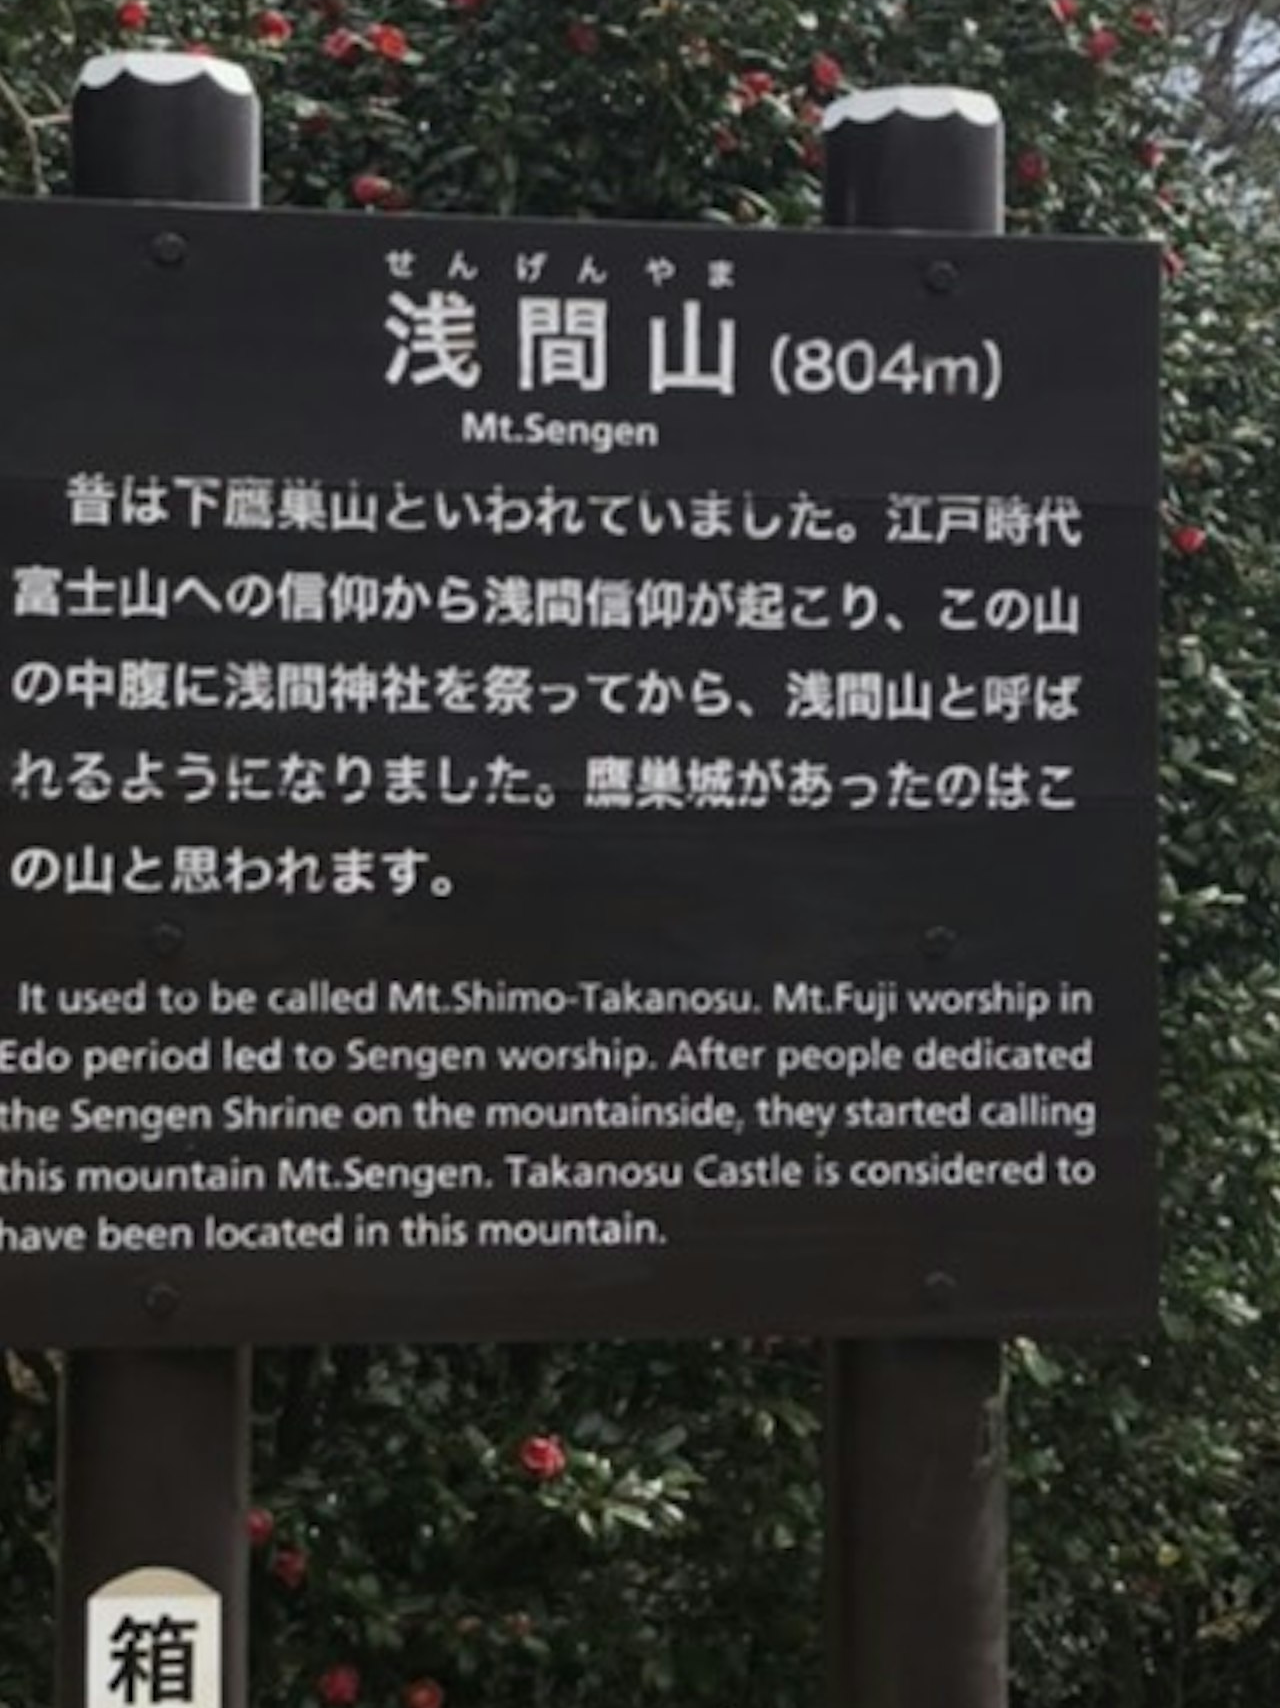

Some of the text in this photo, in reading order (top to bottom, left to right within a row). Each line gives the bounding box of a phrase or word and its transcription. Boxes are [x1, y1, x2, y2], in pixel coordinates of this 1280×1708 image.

[385, 250, 734, 288] せんげんやま
[384, 291, 1003, 400] 浅間山 (804m)
[461, 410, 659, 453] Mt.Sengen
[12, 564, 1080, 635] 富士山への信仰から浅間信仰が起こり、この山
[11, 657, 1082, 724] の中腹に浅間神社を祭ってから、浅間山と呼ば
[10, 844, 456, 897] の山と思われます。
[20, 980, 1092, 1022] It used to be called Mt.Shimo-Takanosu. Mt.Fuji worship in
[84, 1038, 210, 1080] period
[223, 1037, 282, 1072] led
[294, 1043, 335, 1071] to
[346, 1038, 485, 1079] Sengen
[498, 1037, 656, 1078] worship.
[669, 1036, 765, 1070] After
[777, 1038, 903, 1077] people
[913, 1037, 1092, 1070] dedicated
[71, 1098, 212, 1141] Sengen
[223, 1096, 343, 1130] Shrine
[352, 1103, 402, 1129] on
[413, 1095, 475, 1129] the
[486, 1094, 744, 1133] mountainside,
[755, 1094, 836, 1137] they
[845, 1093, 970, 1127] started
[979, 1093, 1095, 1137] calling
[77, 1157, 265, 1192] mountain
[278, 1157, 492, 1197] Mt.Sengen.
[505, 1154, 682, 1188] Takanosu
[694, 1154, 802, 1187] Castle
[815, 1154, 840, 1186] is
[850, 1151, 1046, 1186] considered
[1056, 1157, 1095, 1185] to
[98, 1216, 193, 1251] been
[205, 1213, 343, 1249] located
[355, 1214, 389, 1246] in
[400, 1213, 468, 1247] this
[478, 1211, 666, 1246] mountain.
